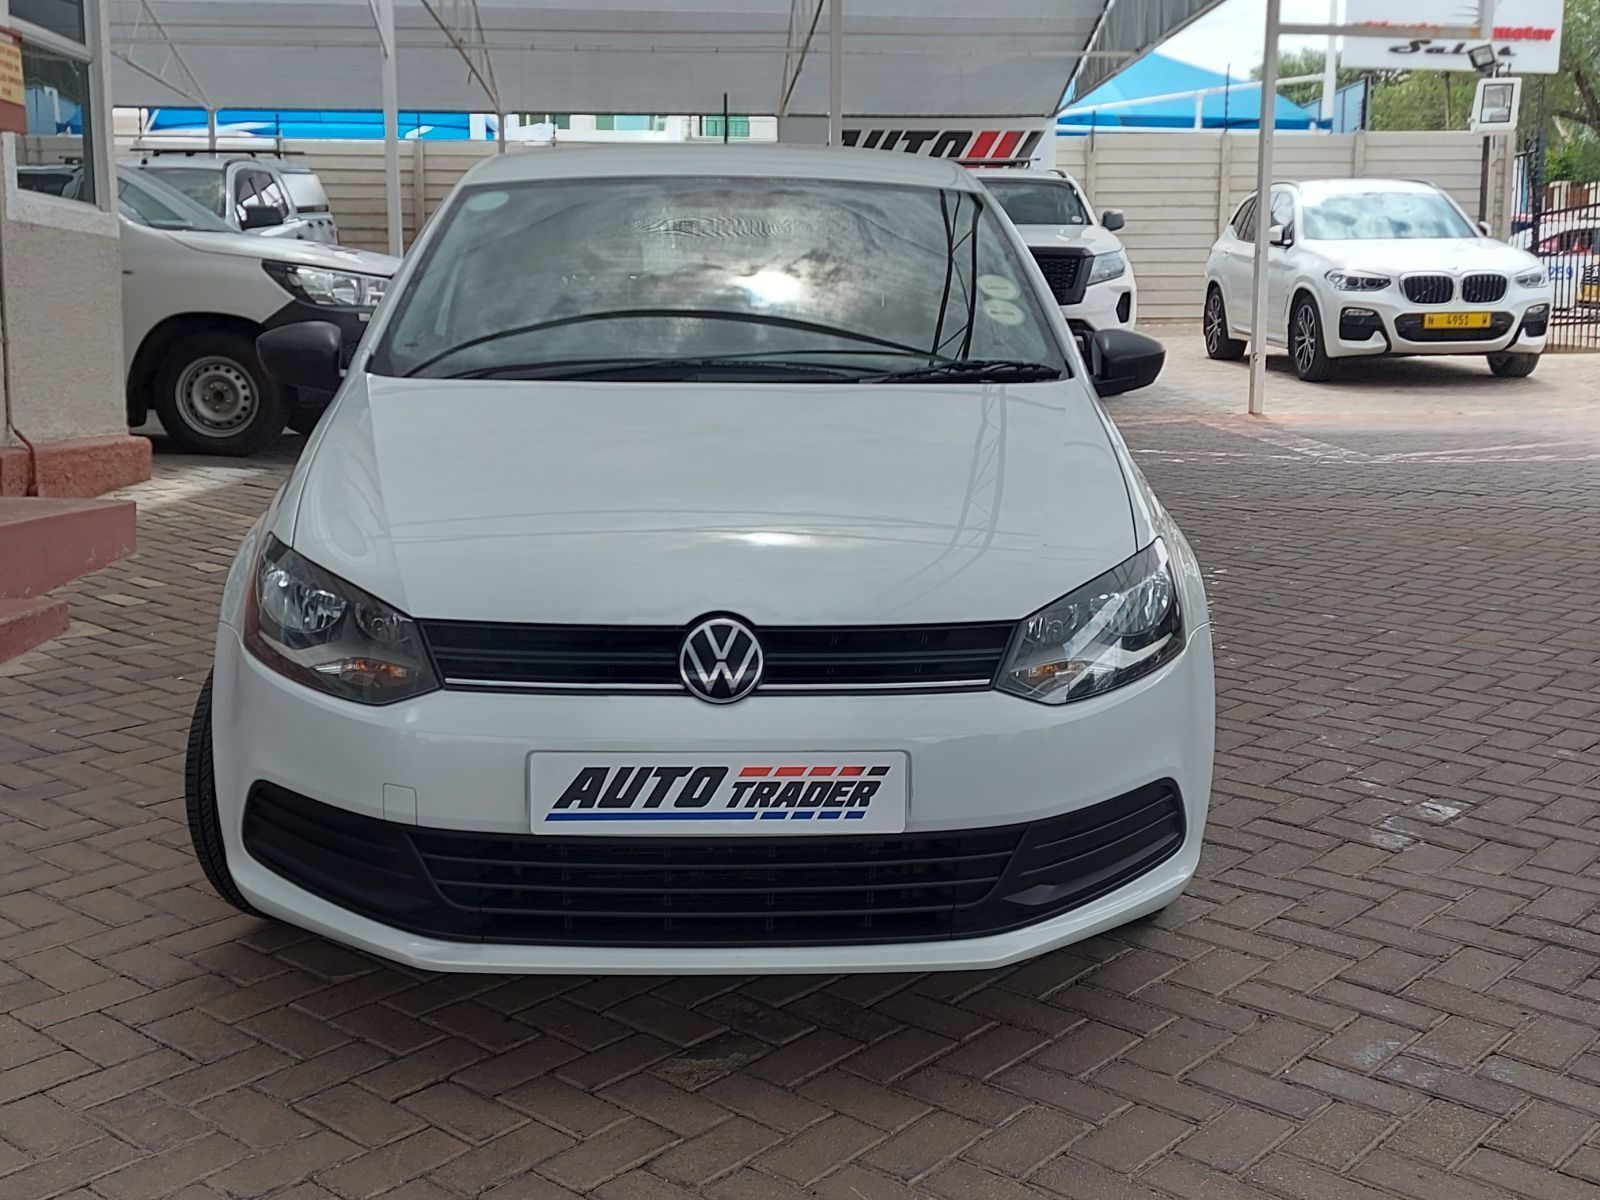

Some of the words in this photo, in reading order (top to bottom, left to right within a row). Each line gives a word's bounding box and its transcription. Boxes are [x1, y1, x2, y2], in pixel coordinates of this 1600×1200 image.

[1492, 26, 1556, 41] motor
[1389, 40, 1517, 57] Sals
[1427, 315, 1434, 325] N
[1447, 314, 1469, 326] 4951
[553, 766, 729, 809] AUTO
[725, 781, 881, 808] TRADER
